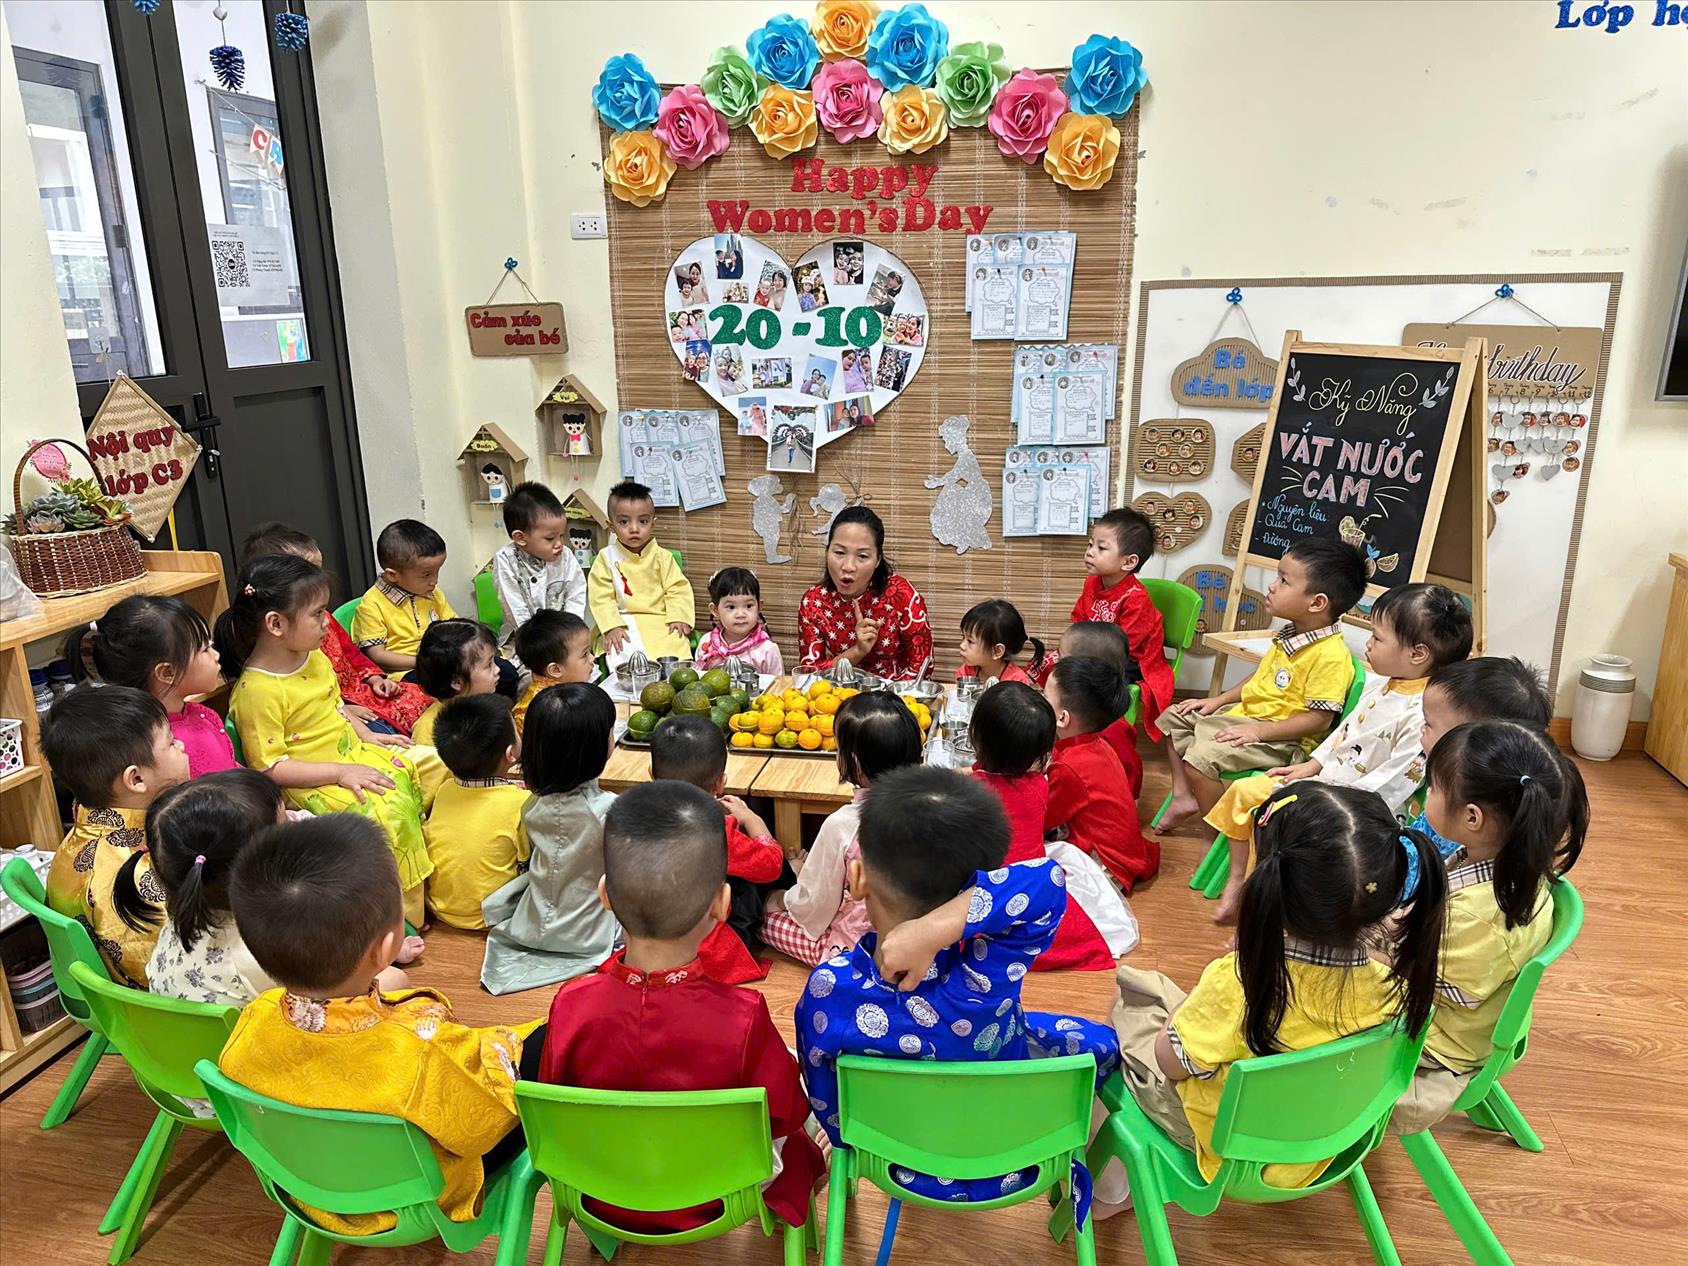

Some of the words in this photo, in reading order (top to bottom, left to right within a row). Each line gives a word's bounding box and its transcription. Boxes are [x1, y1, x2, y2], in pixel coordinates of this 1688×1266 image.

[1555, 0, 1634, 33] Lớp
[791, 158, 939, 200] Happy
[470, 311, 508, 329] Cảm
[511, 310, 542, 327] xúc
[504, 329, 536, 346] của
[539, 328, 561, 345] bé
[1214, 349, 1246, 369] Bé
[1488, 344, 1586, 392] birthday
[1309, 377, 1352, 427] Kỹ
[1355, 372, 1419, 436] Năng
[86, 430, 130, 461] Nội
[133, 425, 176, 453] quy
[1279, 421, 1335, 467] VẮT
[1337, 432, 1425, 484] NƯỚC
[104, 469, 149, 497] lớp
[152, 459, 184, 486] C3
[1302, 470, 1371, 507] CAM
[1264, 513, 1288, 529] Quả
[1292, 518, 1314, 535] Cam
[1266, 493, 1305, 523] Nguyên
[1197, 571, 1226, 590] Bé
[1214, 595, 1257, 614] hc
